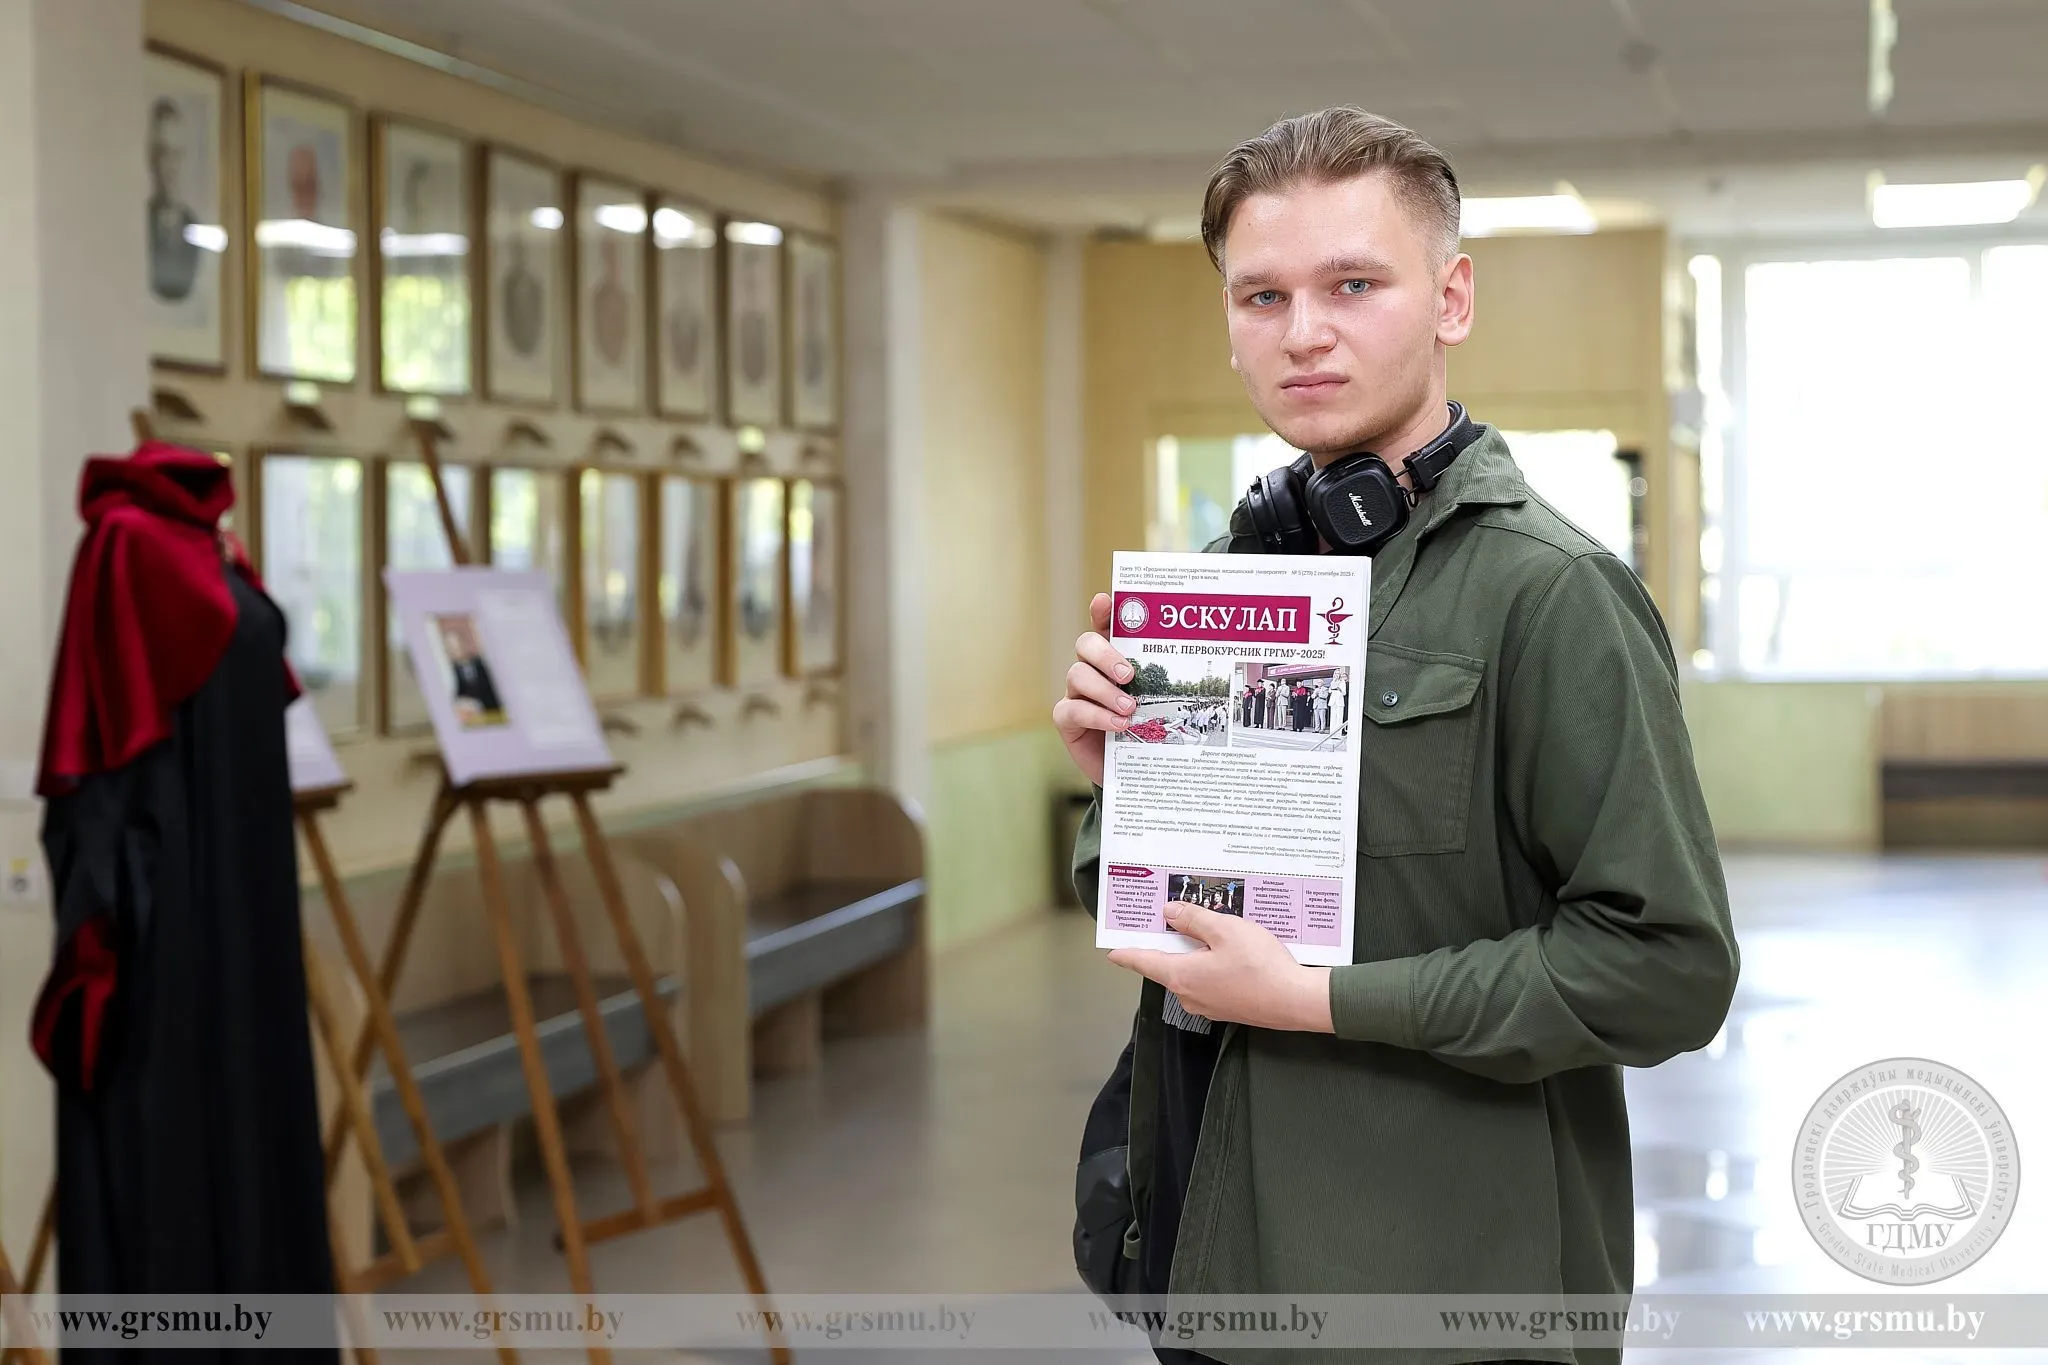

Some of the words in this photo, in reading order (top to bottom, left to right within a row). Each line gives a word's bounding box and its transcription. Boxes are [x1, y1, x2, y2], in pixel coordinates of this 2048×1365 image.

[1348, 492, 1373, 527] Marshall
[1159, 604, 1298, 632] ЭСКУЛАП
[1143, 644, 1178, 654] ВИВАТ,
[1181, 645, 1262, 657] ПЕРВОКУРСНИК
